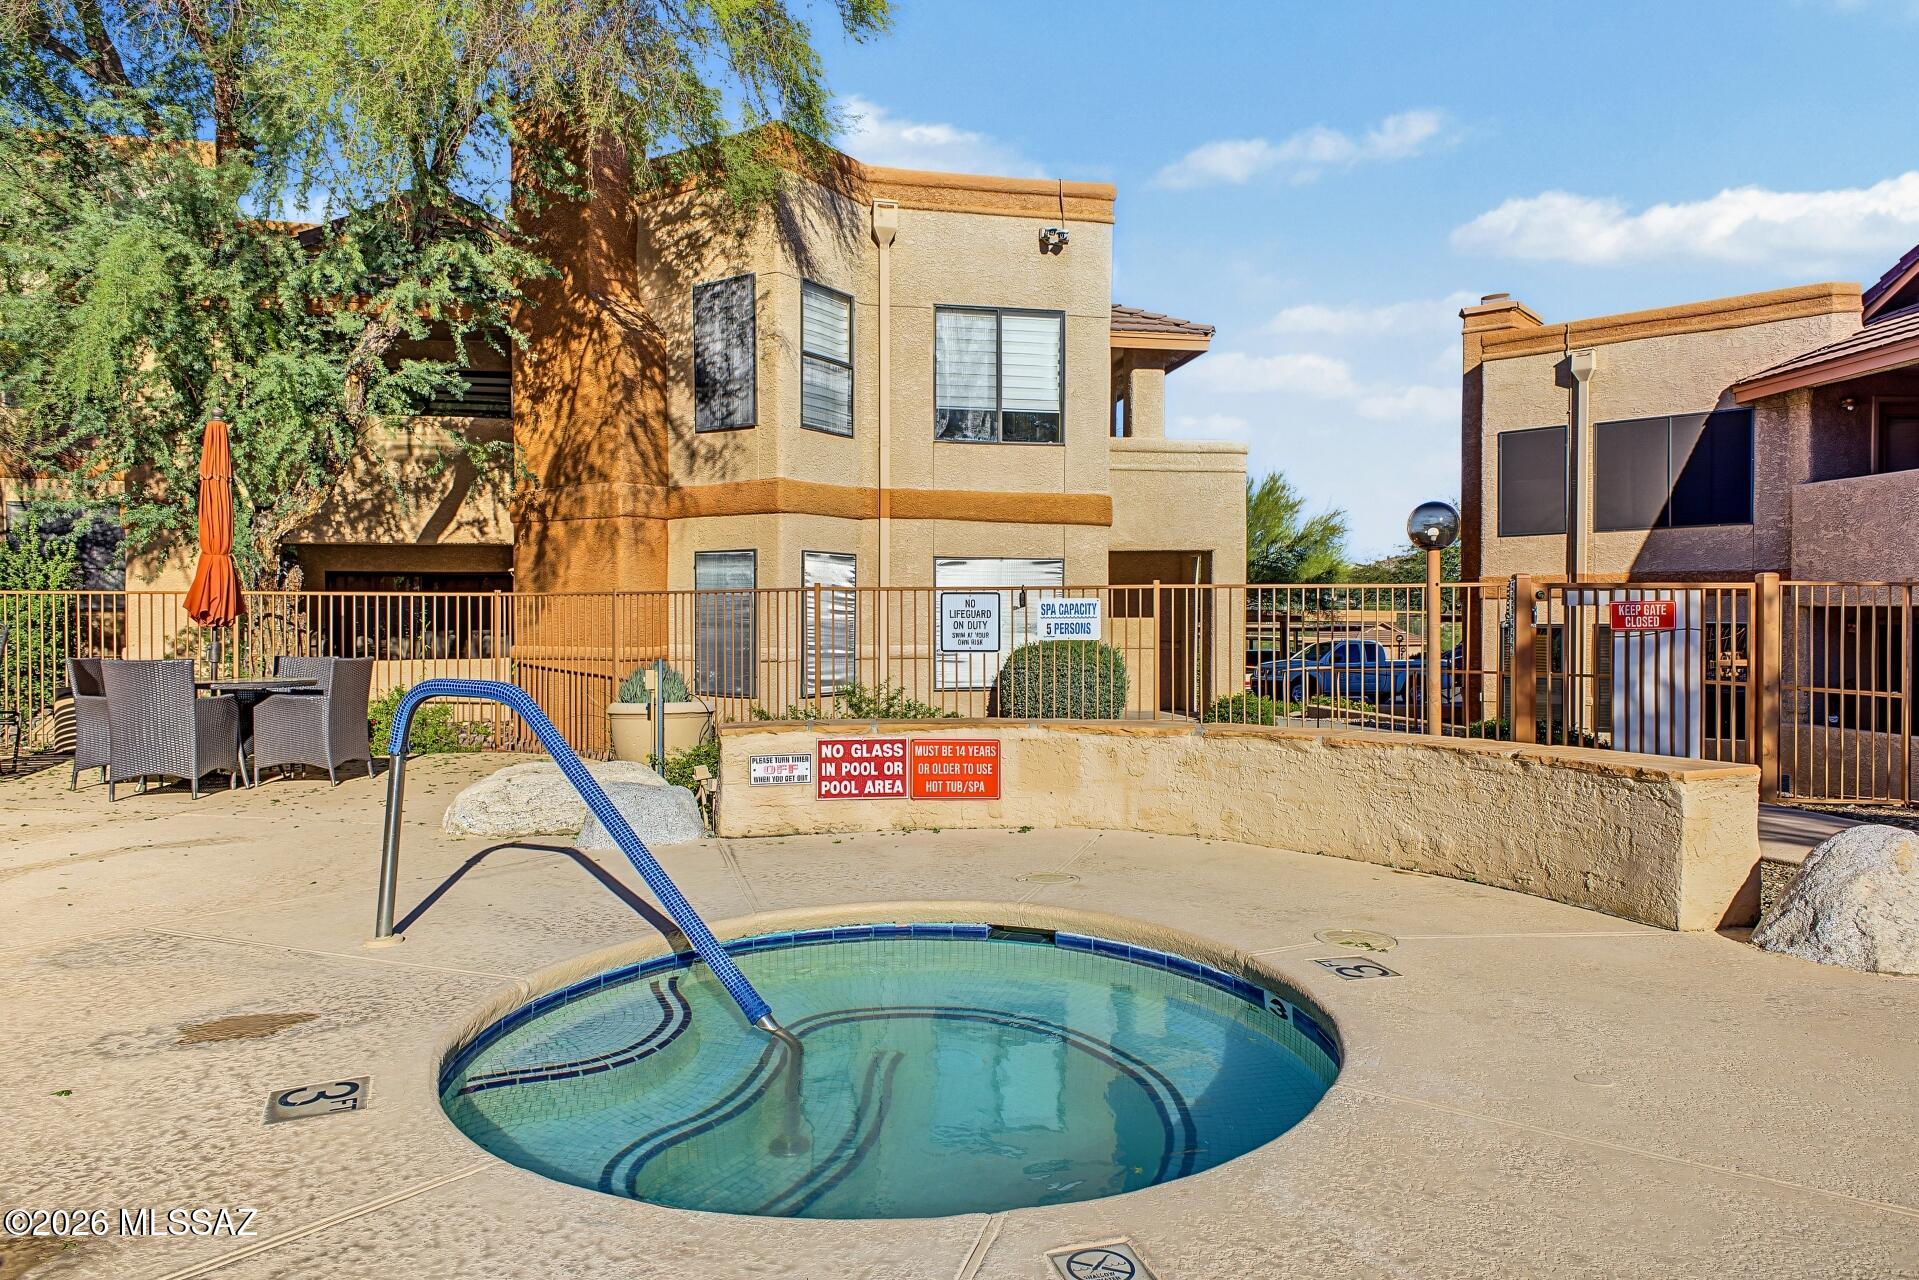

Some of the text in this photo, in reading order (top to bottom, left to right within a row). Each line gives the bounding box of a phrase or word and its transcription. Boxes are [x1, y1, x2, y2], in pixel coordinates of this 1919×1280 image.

[965, 599, 976, 608] NO
[1040, 602, 1097, 616] SPA CAPACITY
[949, 609, 992, 619] LIFEGUARD
[1618, 604, 1667, 616] KEEP GATE
[953, 620, 988, 630] ON DUTY
[1625, 616, 1660, 628] CLOSED
[1046, 622, 1091, 635] 5 PERSONS
[821, 743, 904, 758] NO GLASS
[914, 745, 997, 757] MUST BE 14 YEARS
[763, 764, 799, 774] OFF
[821, 761, 904, 777] IN POOL OR
[918, 763, 993, 775] OR OLDER TO USE
[821, 779, 904, 795] POOL AREA
[925, 781, 985, 793] HOT TUB/SPA
[1335, 964, 1390, 978] 3
[1269, 998, 1289, 1021] 3
[277, 1081, 360, 1107] 3
[328, 1097, 358, 1111] FT
[1083, 1271, 1115, 1280] SHALLOW
